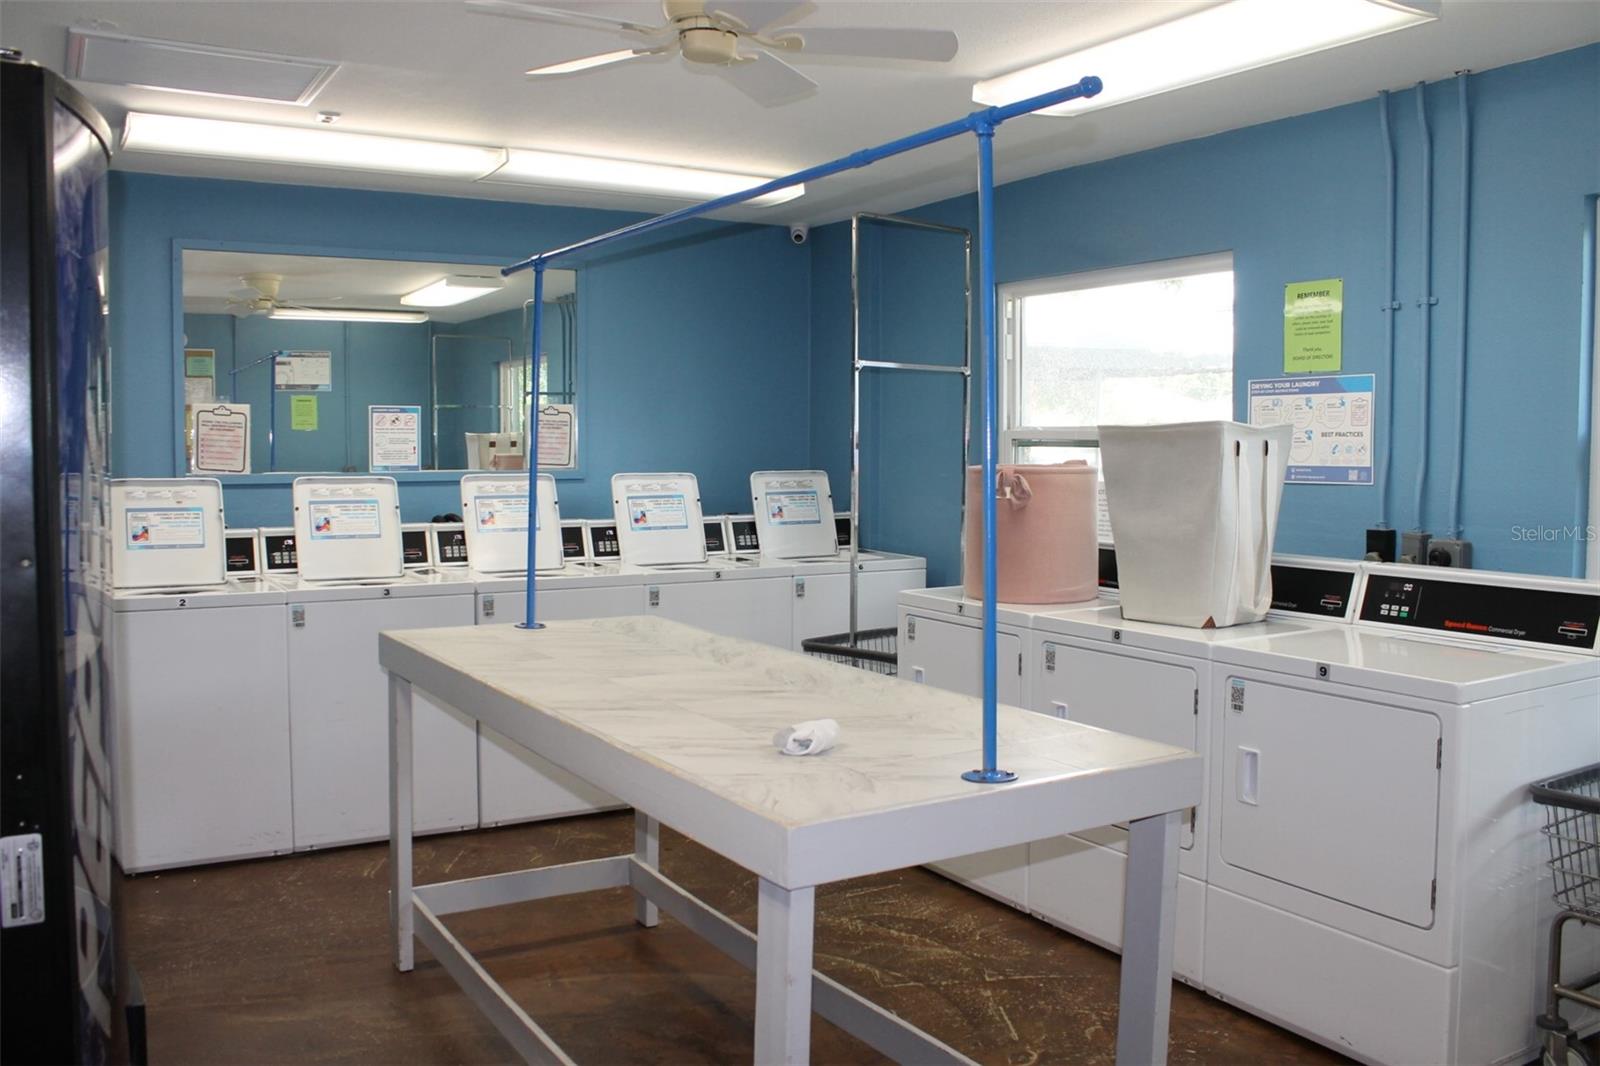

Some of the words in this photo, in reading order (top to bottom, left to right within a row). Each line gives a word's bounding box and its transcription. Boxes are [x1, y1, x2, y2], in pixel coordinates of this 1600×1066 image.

[1297, 290, 1330, 299] REMEMBER
[1291, 380, 1320, 388] LAUNDRY
[383, 588, 390, 596] 3
[178, 599, 186, 607] 2
[958, 605, 963, 613] 7
[1114, 631, 1120, 639] 8
[1319, 666, 1327, 677] 9
